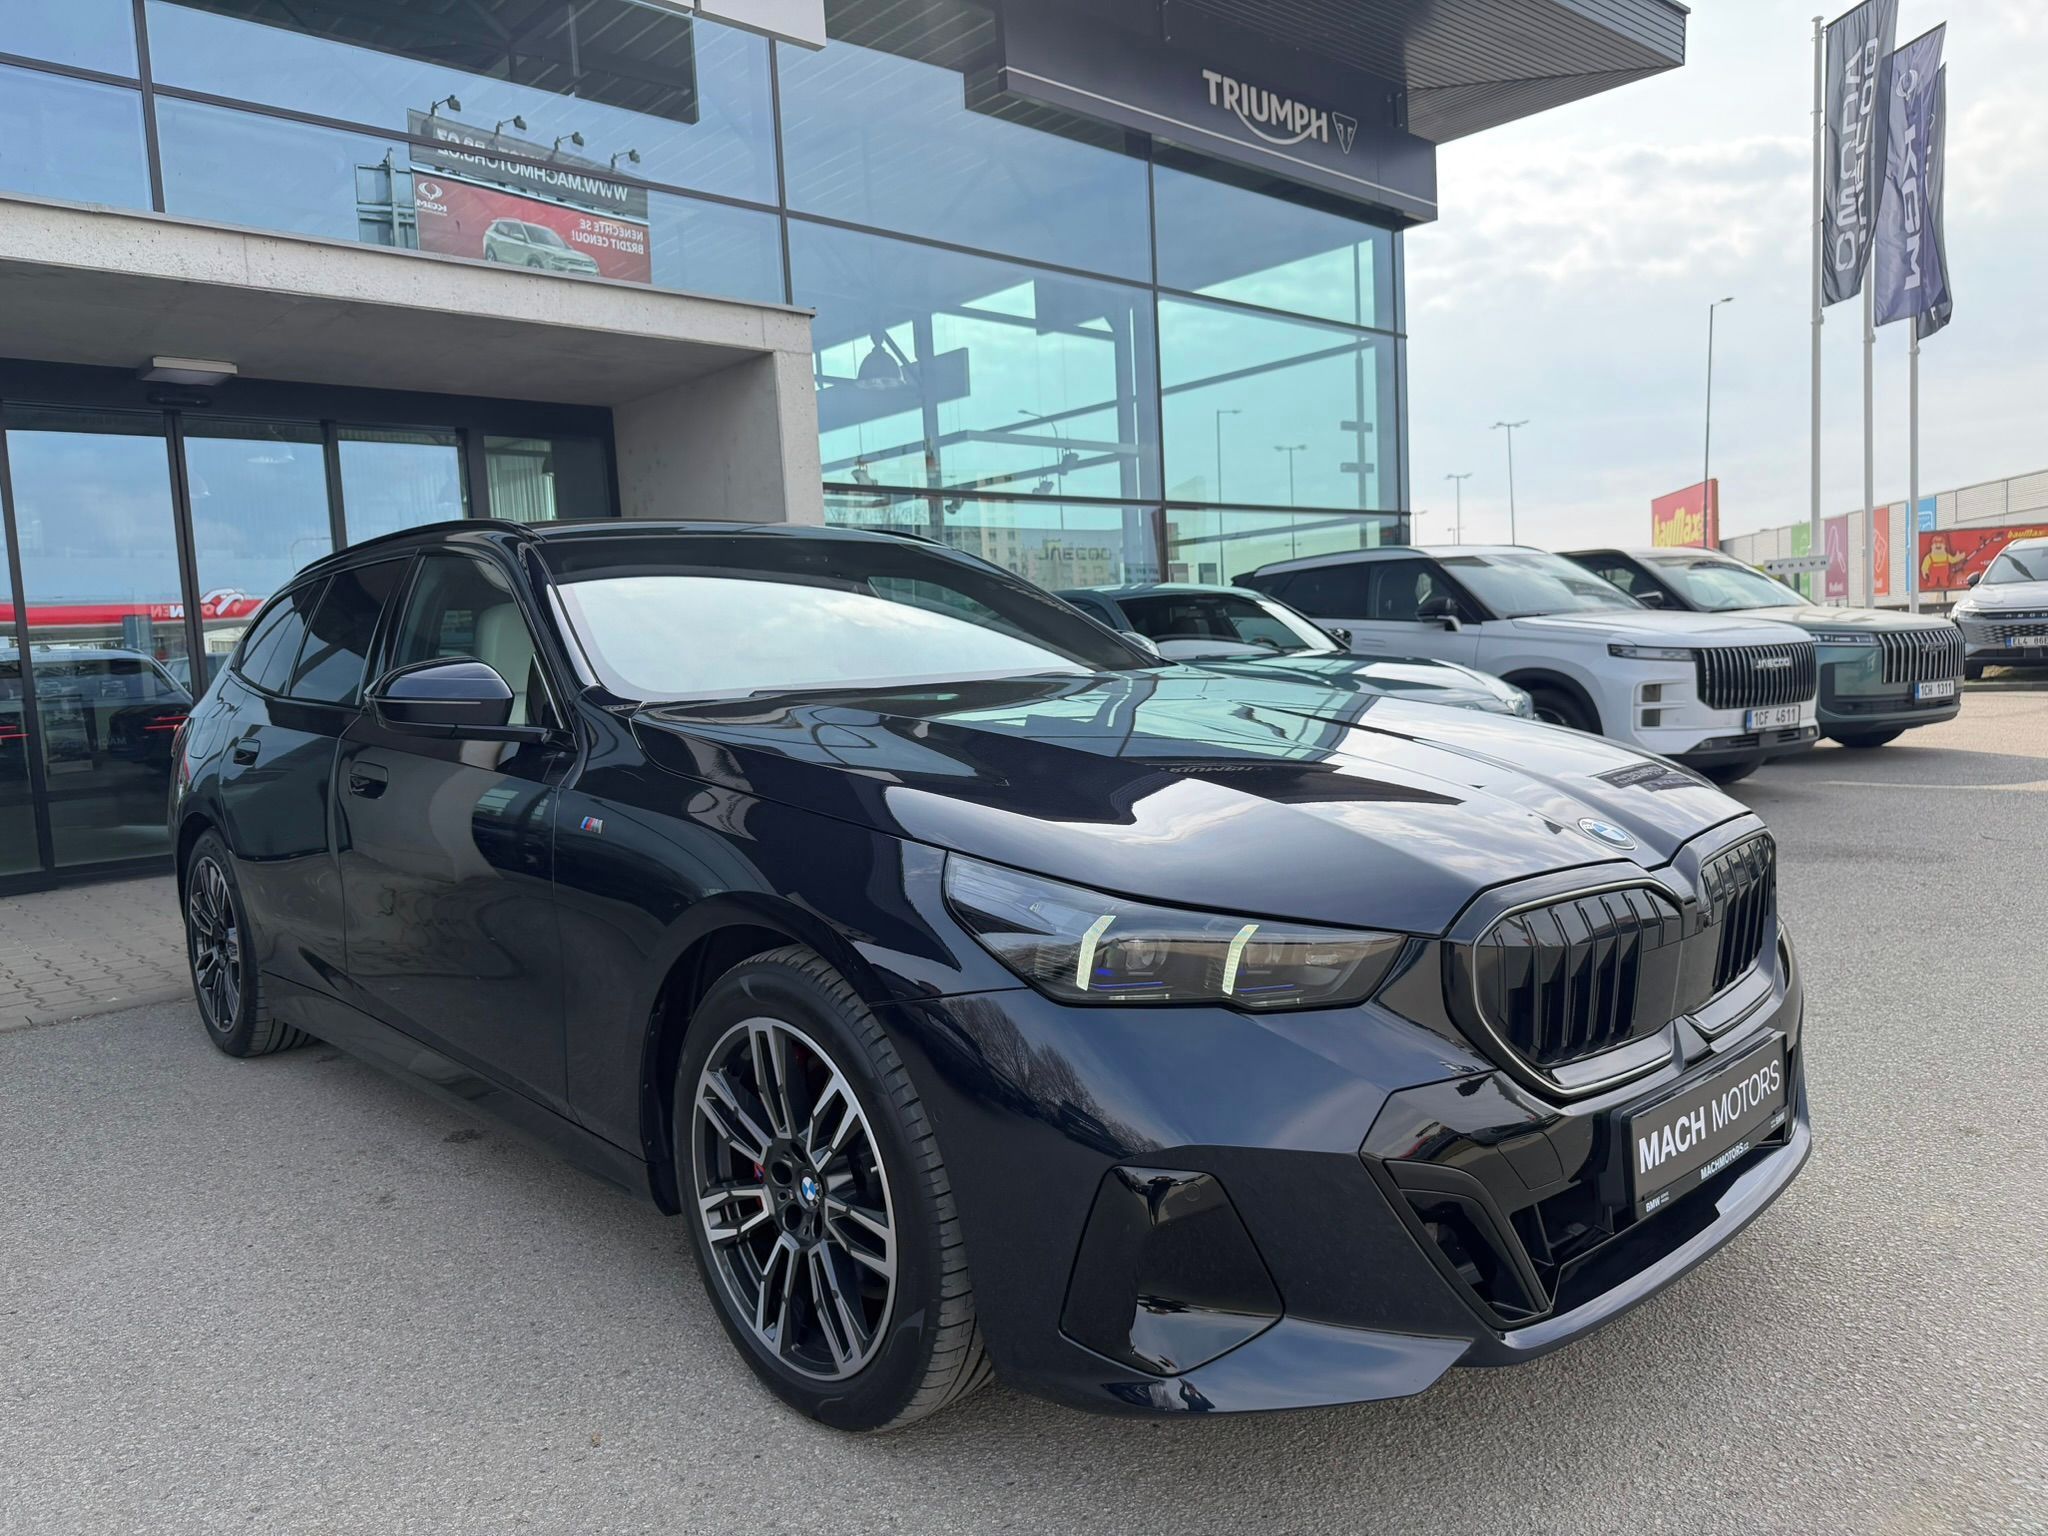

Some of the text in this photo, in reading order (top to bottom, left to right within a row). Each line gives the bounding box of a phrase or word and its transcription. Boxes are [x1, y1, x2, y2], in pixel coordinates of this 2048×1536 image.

[1202, 68, 1328, 144] TRIUMPH
[1835, 46, 1862, 271] OMODA
[1902, 124, 1921, 291] KGM
[1756, 657, 1790, 669] JAECOO
[1920, 680, 1952, 696] 1CH 1311
[1754, 708, 1797, 726] 1CF 4611
[1638, 1059, 1781, 1174] MACH MOTORS
